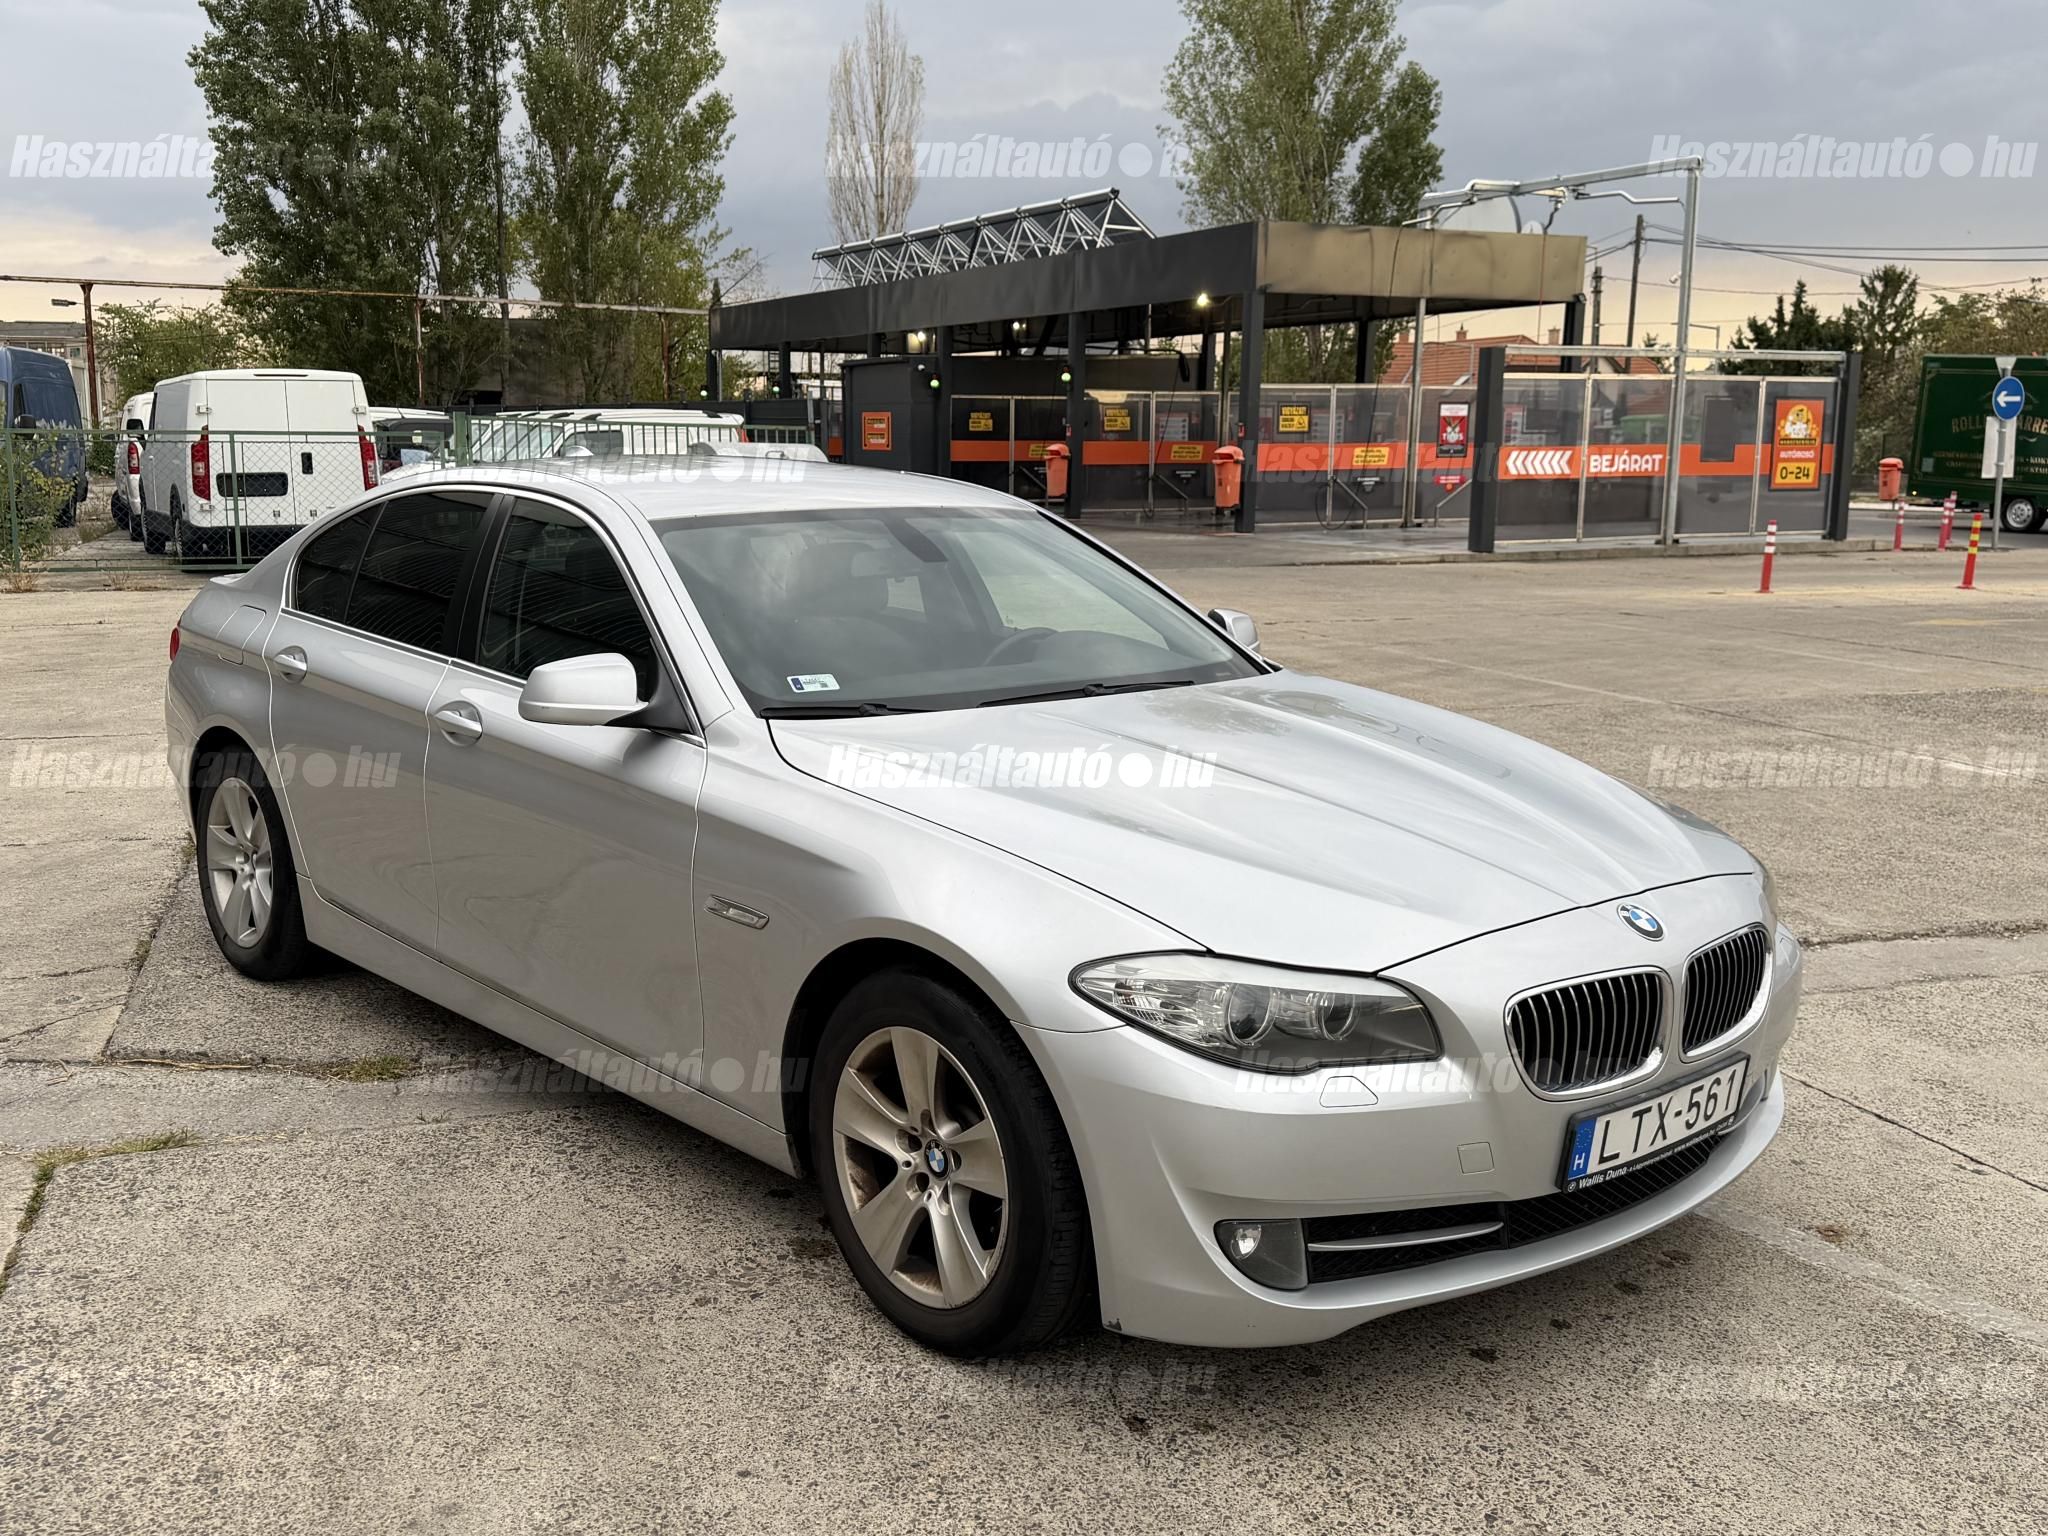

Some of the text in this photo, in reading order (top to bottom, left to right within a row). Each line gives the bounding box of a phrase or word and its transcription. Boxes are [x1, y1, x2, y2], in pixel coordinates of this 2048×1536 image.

[1590, 449, 1663, 473] BEJÁRAT
[1780, 466, 1810, 480] 0-24
[1597, 1068, 1738, 1166] LTX-561
[1573, 1153, 1586, 1171] H
[1579, 1166, 1628, 1189] Wallis Duna
